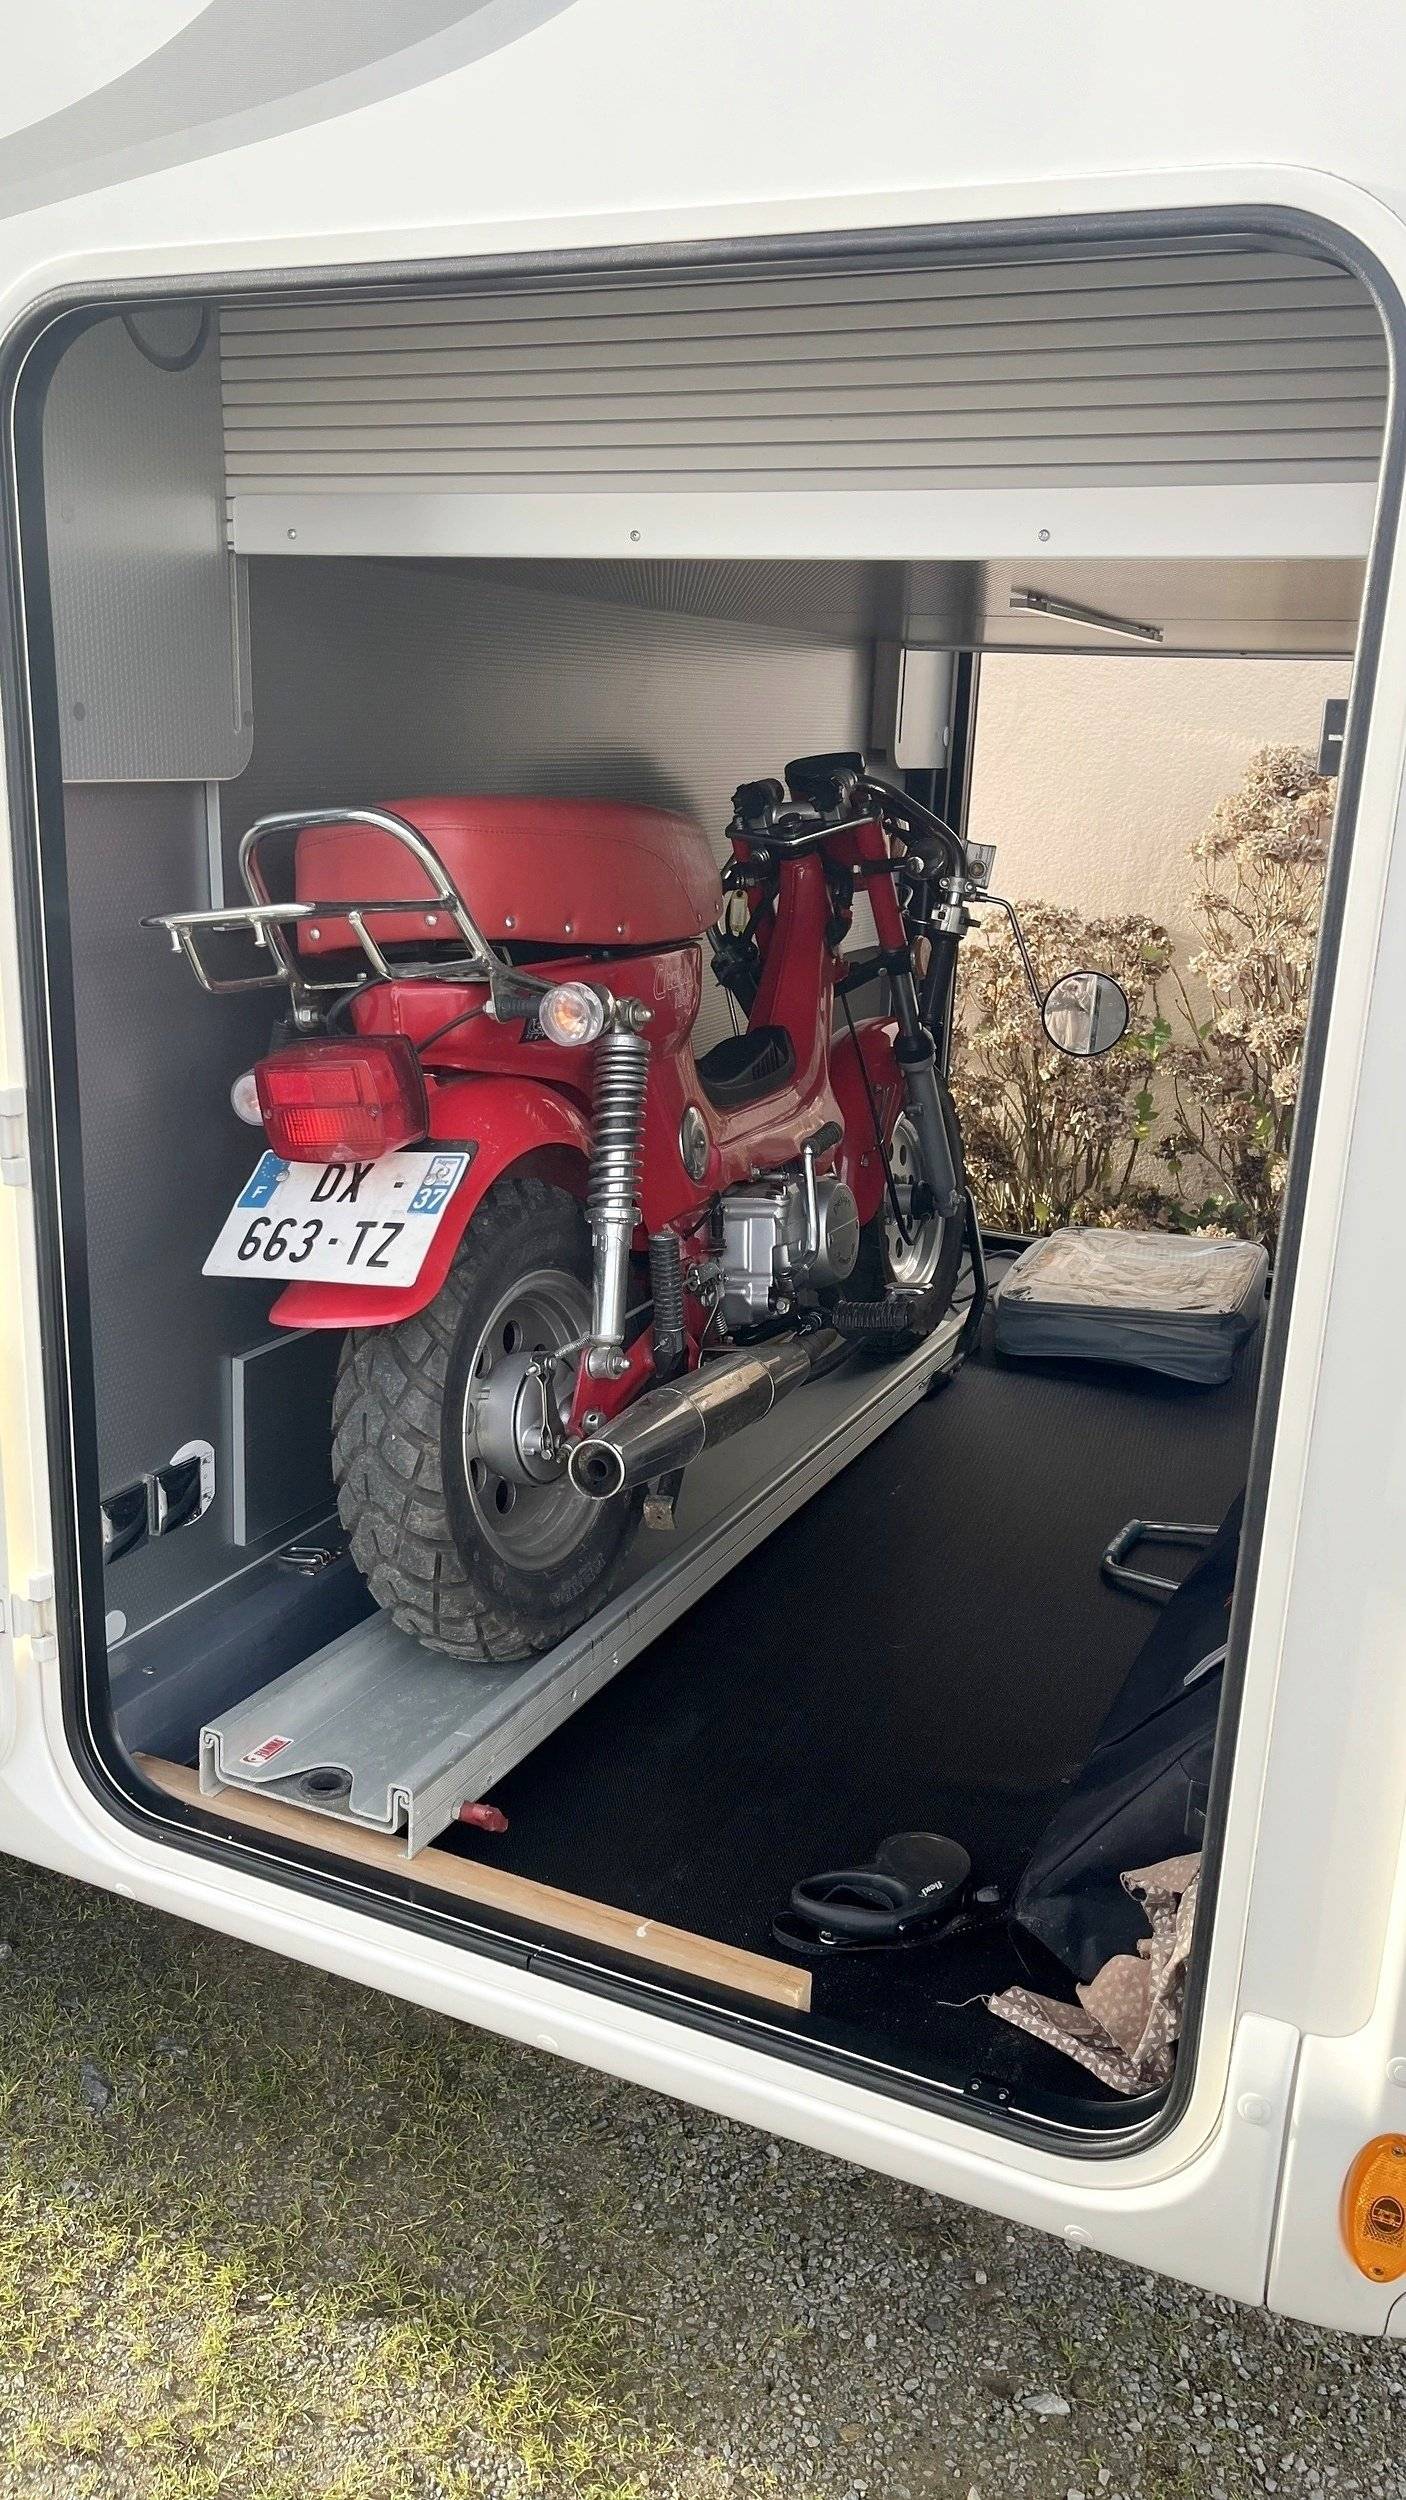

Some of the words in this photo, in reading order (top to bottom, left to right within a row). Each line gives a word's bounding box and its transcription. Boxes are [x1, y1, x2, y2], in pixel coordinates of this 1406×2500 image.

[252, 1185, 268, 1199] F
[310, 1163, 375, 1203] DX
[412, 1187, 446, 1210] 37
